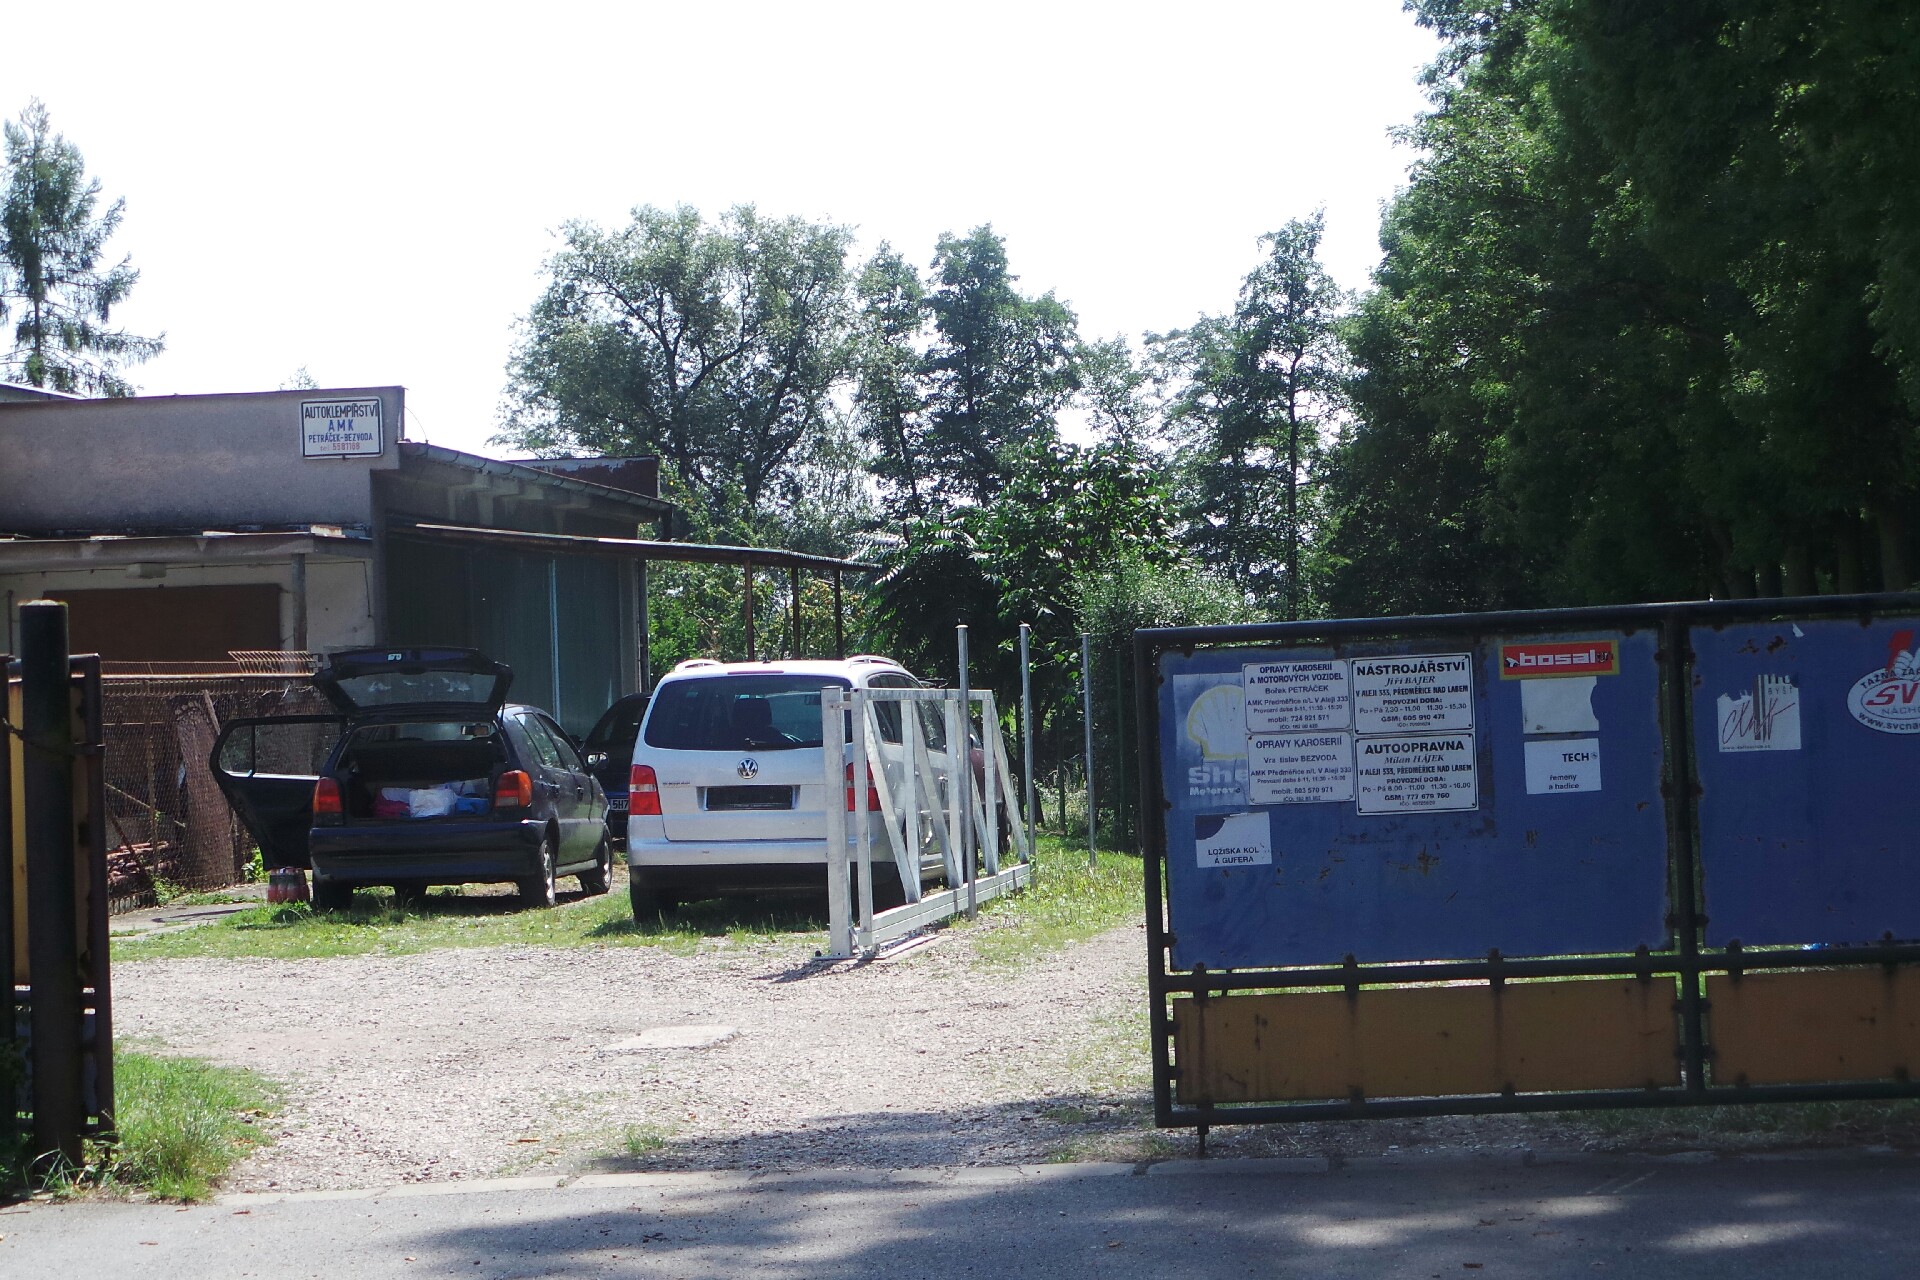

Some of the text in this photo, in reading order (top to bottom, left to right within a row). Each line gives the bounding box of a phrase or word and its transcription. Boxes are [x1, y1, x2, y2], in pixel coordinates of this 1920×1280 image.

[305, 403, 378, 419] AUTOKLEMPÍŘSTVÍ
[328, 419, 354, 432] AMK
[1520, 649, 1596, 666] bosal
[1260, 662, 1332, 673] OPRAVY KAROSERIÍ
[1357, 659, 1465, 676] NÁSTROJÁŘSTVÍ
[1257, 673, 1309, 684] MOTOROVÝCH
[1312, 673, 1343, 681] VOZIDEL
[1384, 676, 1435, 687] Jiří BAJER
[1288, 684, 1329, 693] PETRÁČEK
[1393, 686, 1431, 696] PŘEDMĚŘICE
[1256, 735, 1342, 749] OPRAVY KAROSERIÍ
[1365, 740, 1464, 754] AUTOOPRAVNA
[1384, 754, 1444, 764] Milan HÁJEK
[1562, 752, 1589, 762] TECH
[1268, 768, 1304, 776] Předměřice
[1365, 768, 1381, 776] ALEJI
[1397, 765, 1435, 774] PŘEDMĚŘICE
[1208, 846, 1259, 855] LOŽISKA KOL
[1222, 856, 1254, 864] GUFERA
